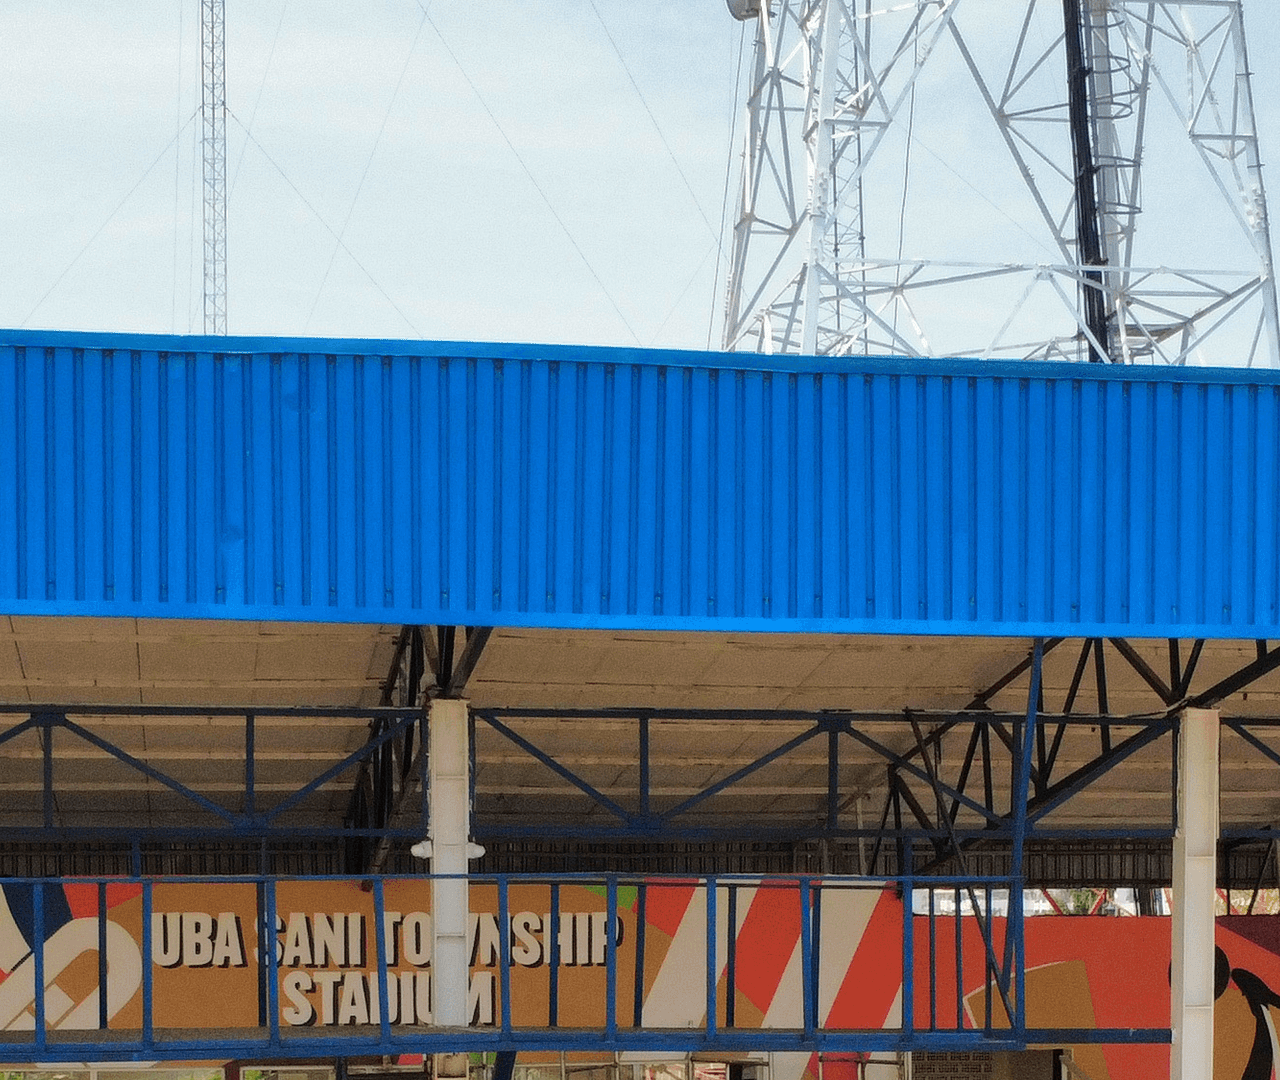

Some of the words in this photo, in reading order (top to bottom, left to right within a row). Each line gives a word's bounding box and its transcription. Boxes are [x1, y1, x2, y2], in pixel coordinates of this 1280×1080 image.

[150, 912, 248, 968] UBA
[376, 911, 624, 968] TONSHIP
[282, 970, 496, 1026] STADIUM
